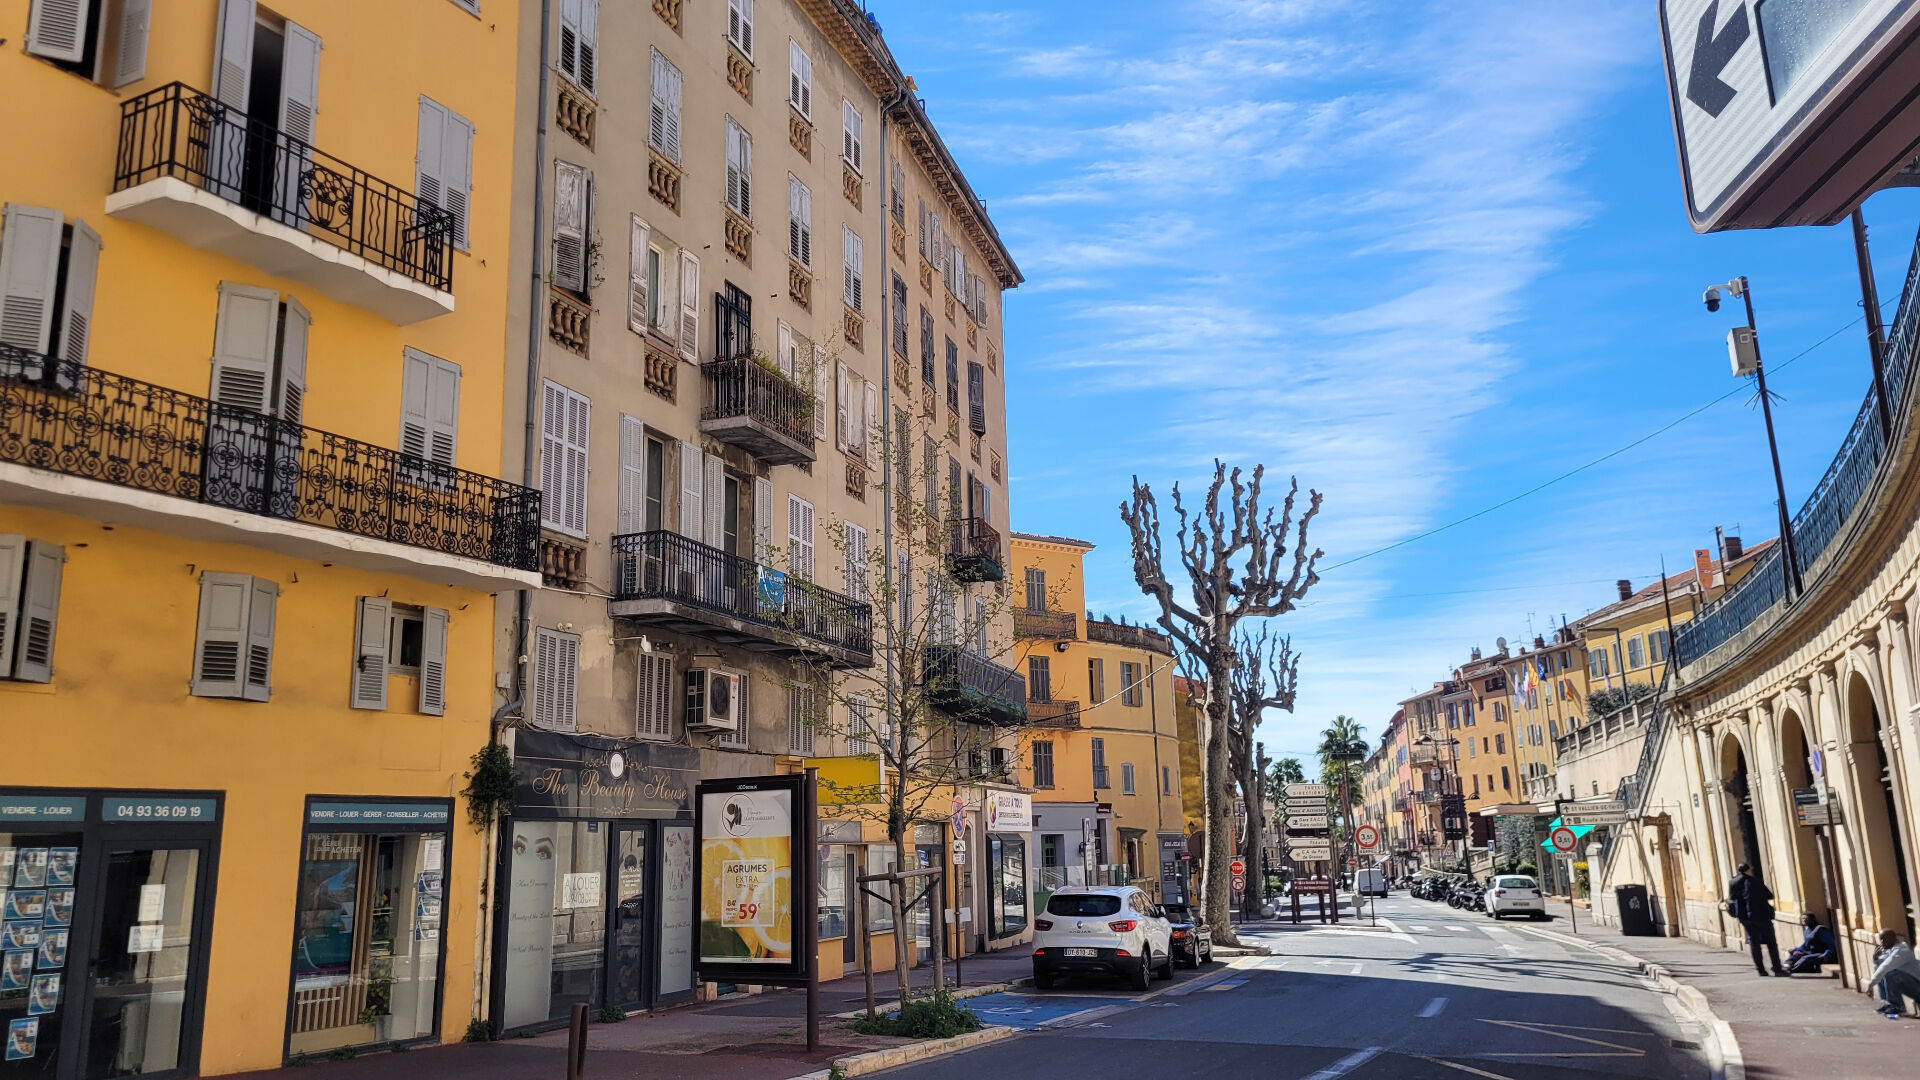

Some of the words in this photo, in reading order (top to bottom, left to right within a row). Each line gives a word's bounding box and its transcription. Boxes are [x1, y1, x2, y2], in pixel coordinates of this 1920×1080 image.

[532, 767, 569, 795] The
[580, 769, 635, 807] Beauty
[643, 774, 688, 800] House
[1, 806, 37, 815] VENDRE
[43, 806, 73, 815] LOUER
[118, 805, 134, 817] 04
[136, 805, 152, 817] 93
[154, 806, 170, 817] 36
[172, 806, 187, 817] 09
[190, 806, 202, 817] 19
[311, 810, 336, 818] VENDRE
[339, 810, 359, 818] LOUER
[423, 811, 448, 819] ACHETER
[331, 846, 362, 854] ACHETER
[726, 863, 768, 874] AGRUMES
[573, 876, 600, 891] LOUER
[735, 875, 759, 883] EXTRA
